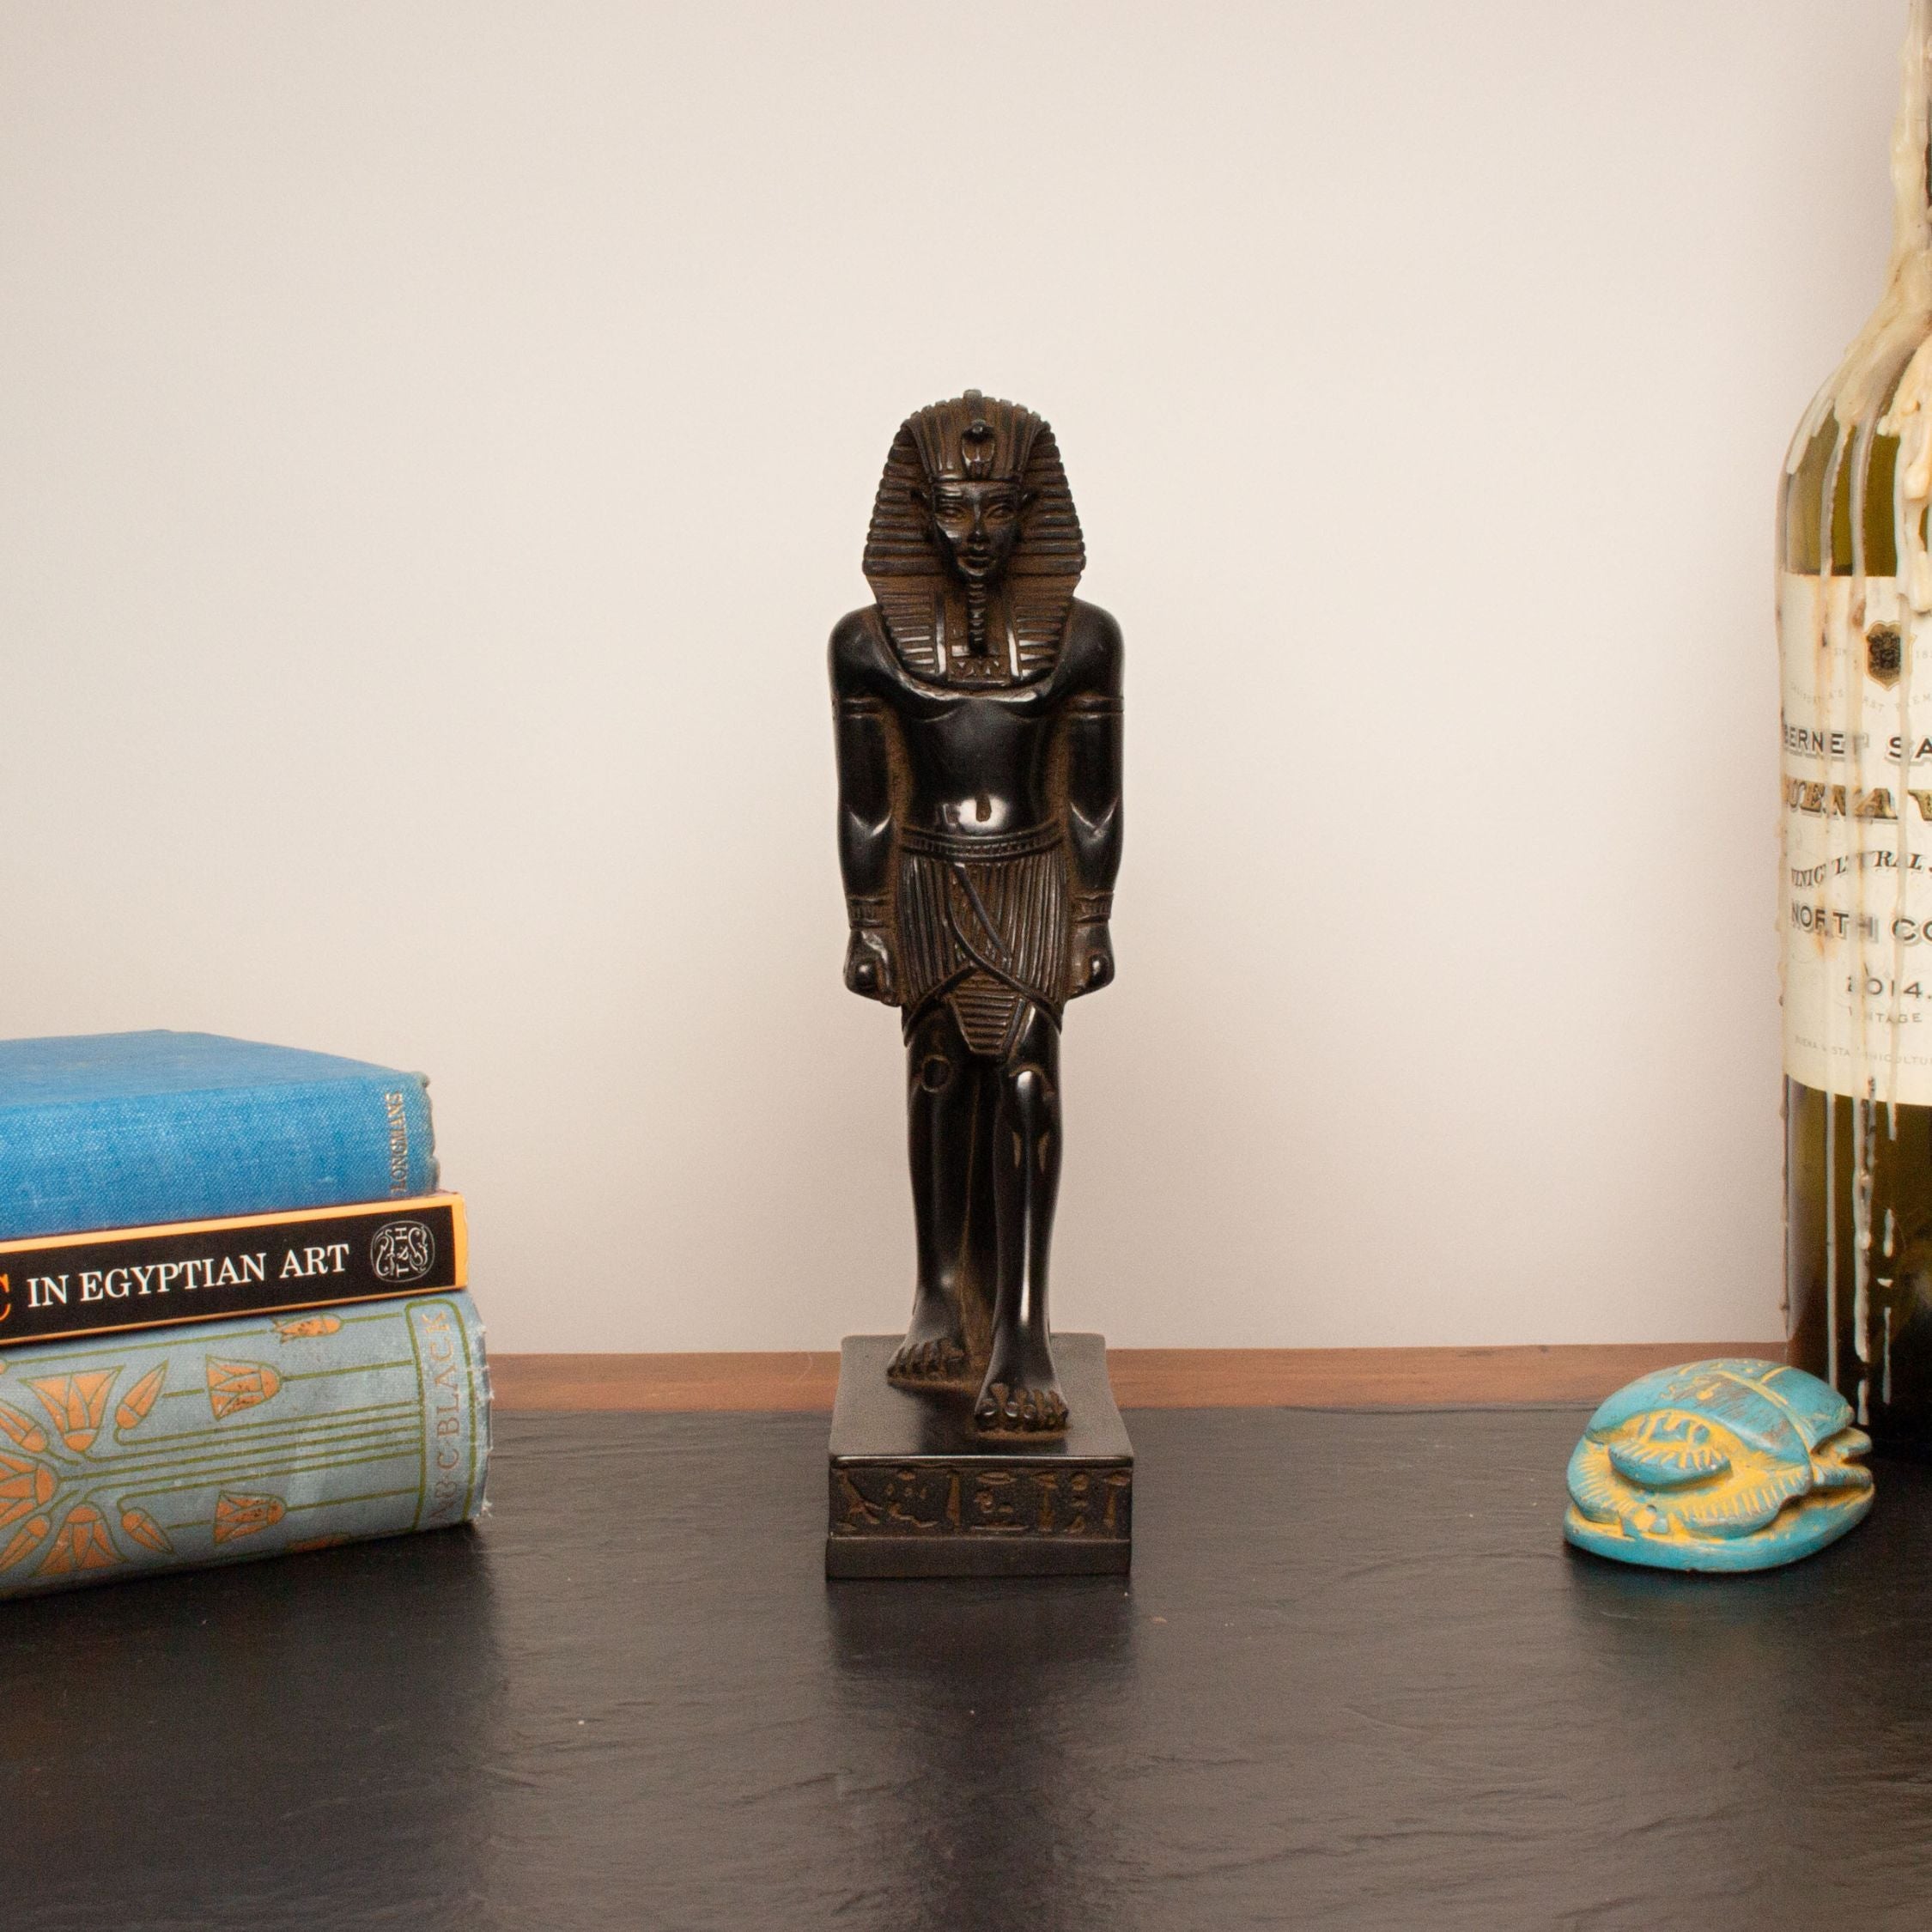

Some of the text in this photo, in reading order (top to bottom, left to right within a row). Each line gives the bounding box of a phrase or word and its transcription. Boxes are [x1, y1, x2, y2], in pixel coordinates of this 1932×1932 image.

[386, 1091, 409, 1194] LONGMANS
[27, 1275, 70, 1308] IN
[79, 1252, 267, 1303] EGYPTIAN
[279, 1243, 350, 1279] ART
